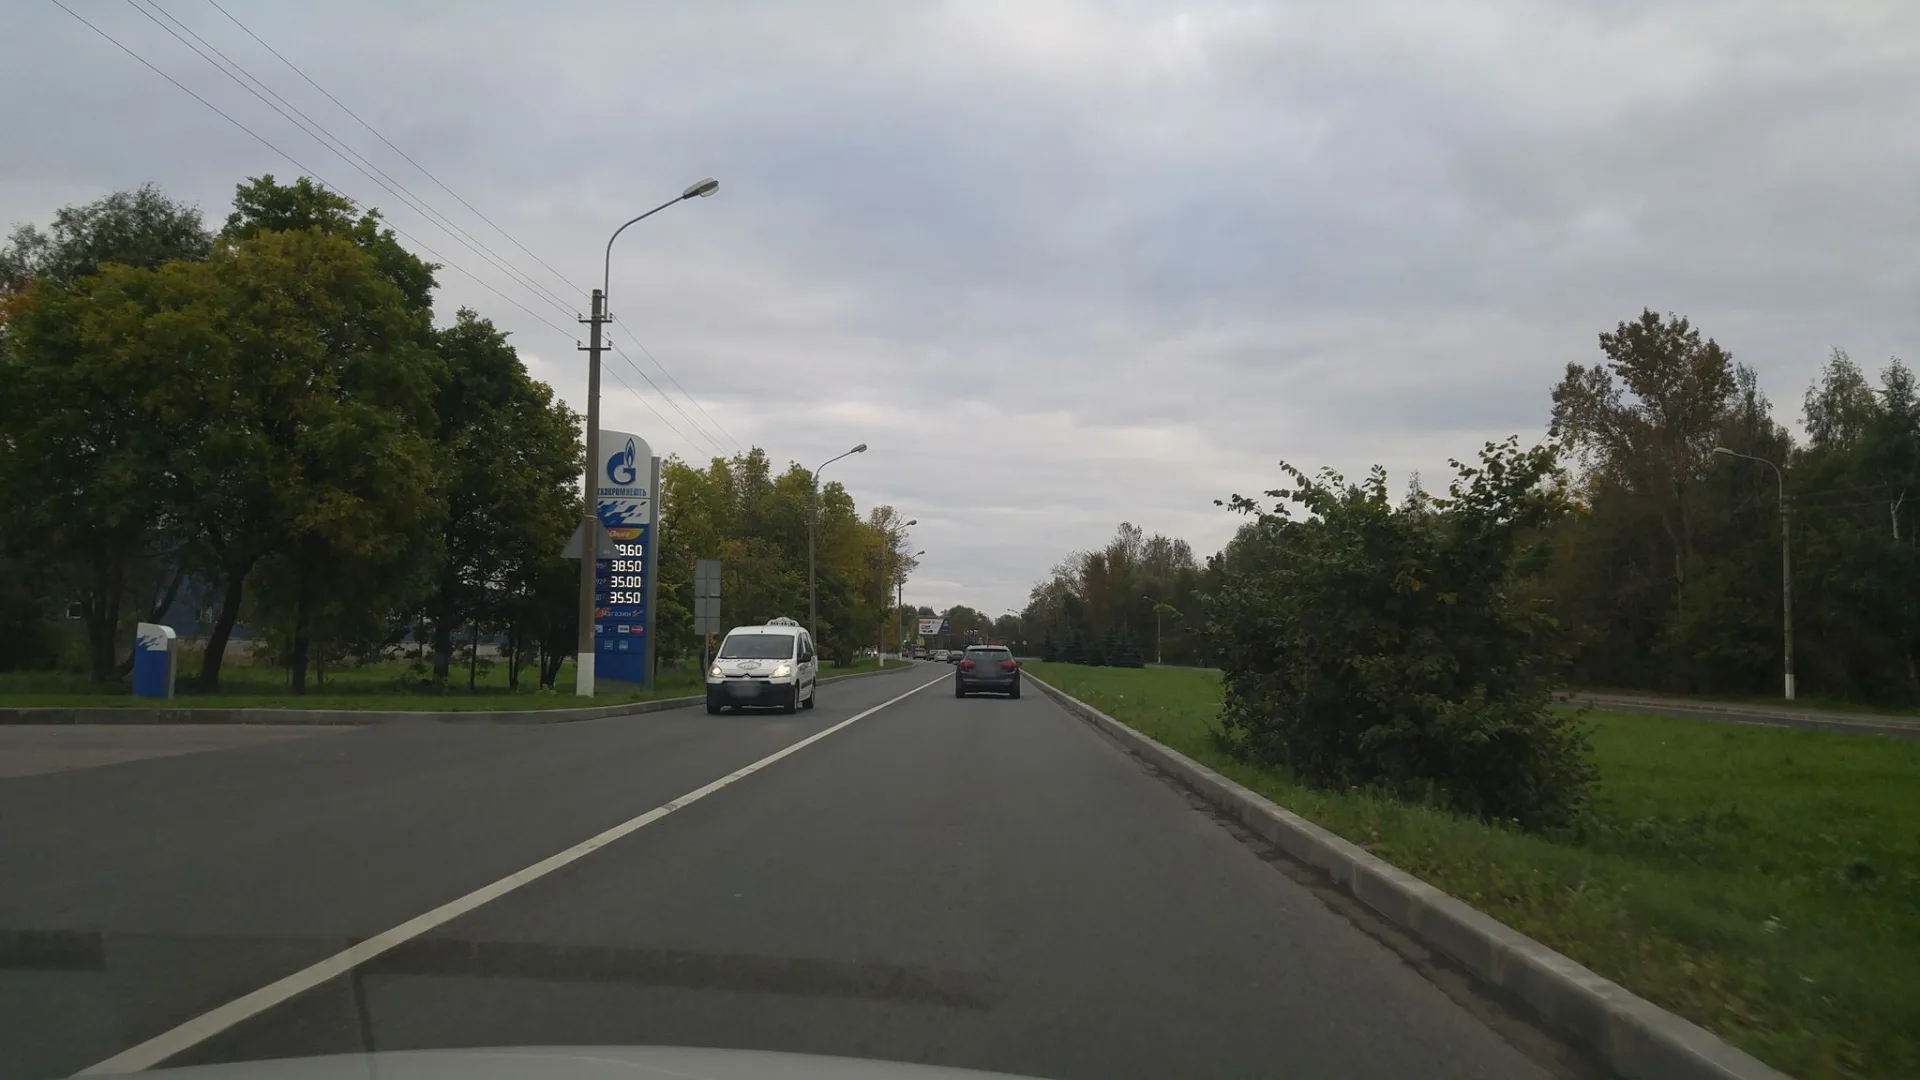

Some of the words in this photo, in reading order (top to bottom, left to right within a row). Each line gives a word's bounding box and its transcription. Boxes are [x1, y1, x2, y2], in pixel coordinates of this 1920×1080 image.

[614, 544, 643, 556] 9.60
[611, 560, 642, 572] 38.50
[611, 576, 641, 588] 35.00
[610, 591, 641, 604] 35.50
